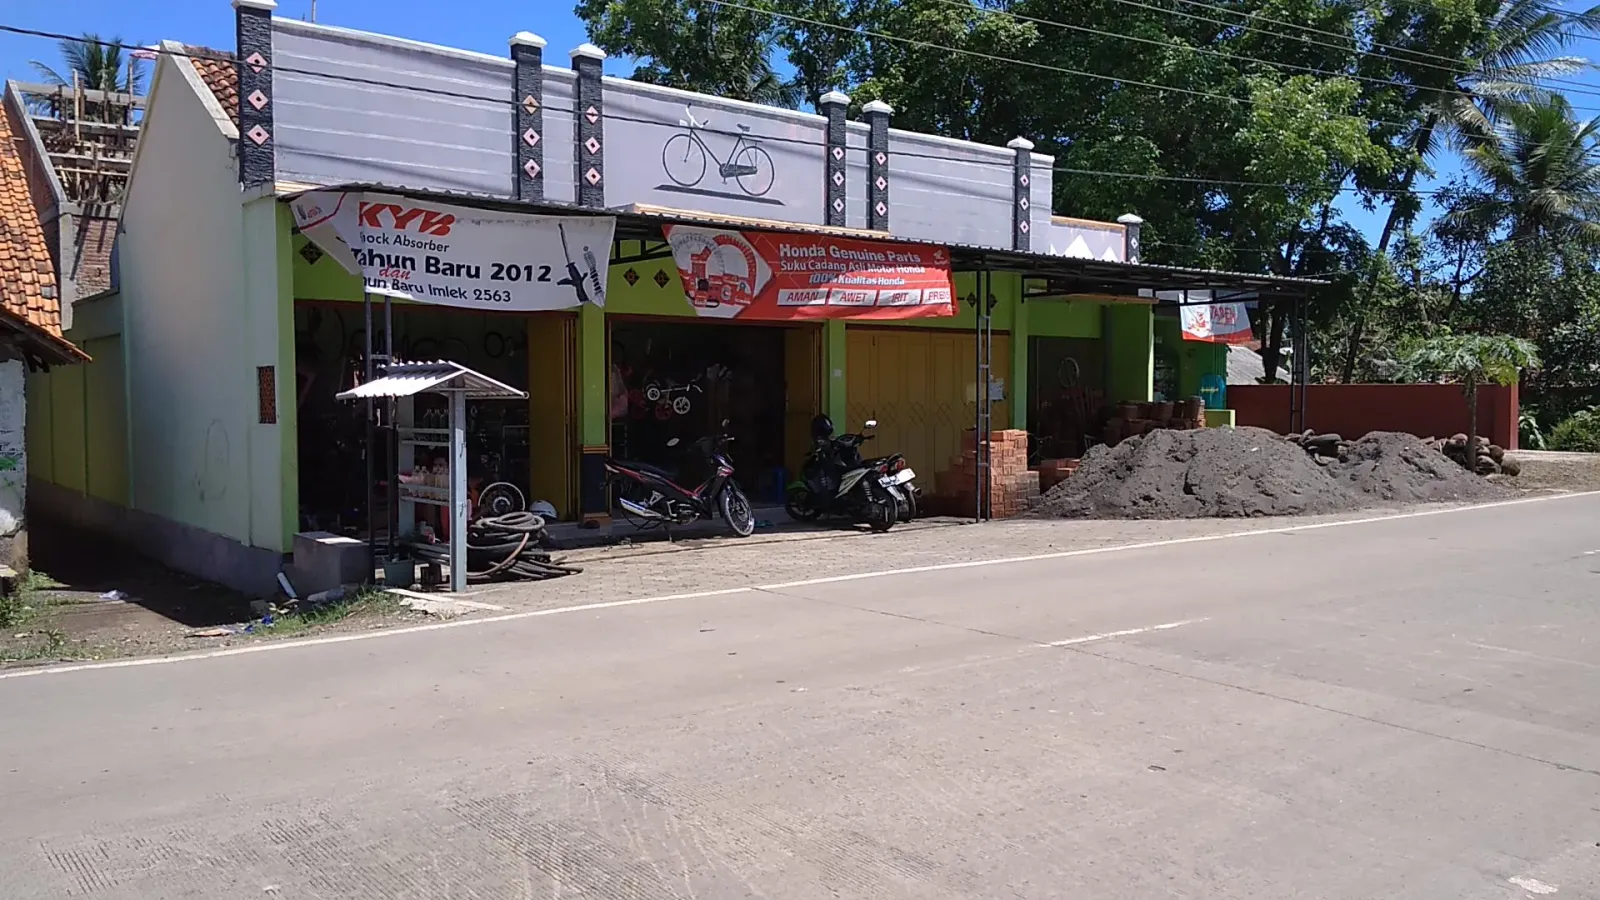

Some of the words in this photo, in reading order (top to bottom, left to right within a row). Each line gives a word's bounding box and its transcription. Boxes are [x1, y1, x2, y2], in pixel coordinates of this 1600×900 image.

[358, 201, 456, 236] KYB
[393, 234, 450, 252] Absorber
[779, 243, 826, 258] Honda
[829, 245, 886, 261] Genuine
[887, 250, 921, 264] Parts
[351, 247, 416, 271] Tahun
[425, 255, 481, 279] Baru
[490, 262, 552, 282] 2012
[378, 263, 412, 280] dan
[780, 260, 806, 271] Suku
[808, 259, 847, 274] Cadang
[848, 261, 866, 272] Asli
[867, 263, 895, 274] Motor
[896, 264, 926, 274] Honda
[809, 272, 837, 284] 100%
[838, 274, 878, 286] Kualitas
[877, 277, 905, 286] Honda
[391, 278, 424, 294] Baru
[428, 284, 468, 300] Imlek
[473, 288, 511, 302] 2563
[787, 292, 819, 302] AMAN
[839, 292, 868, 303] AWET
